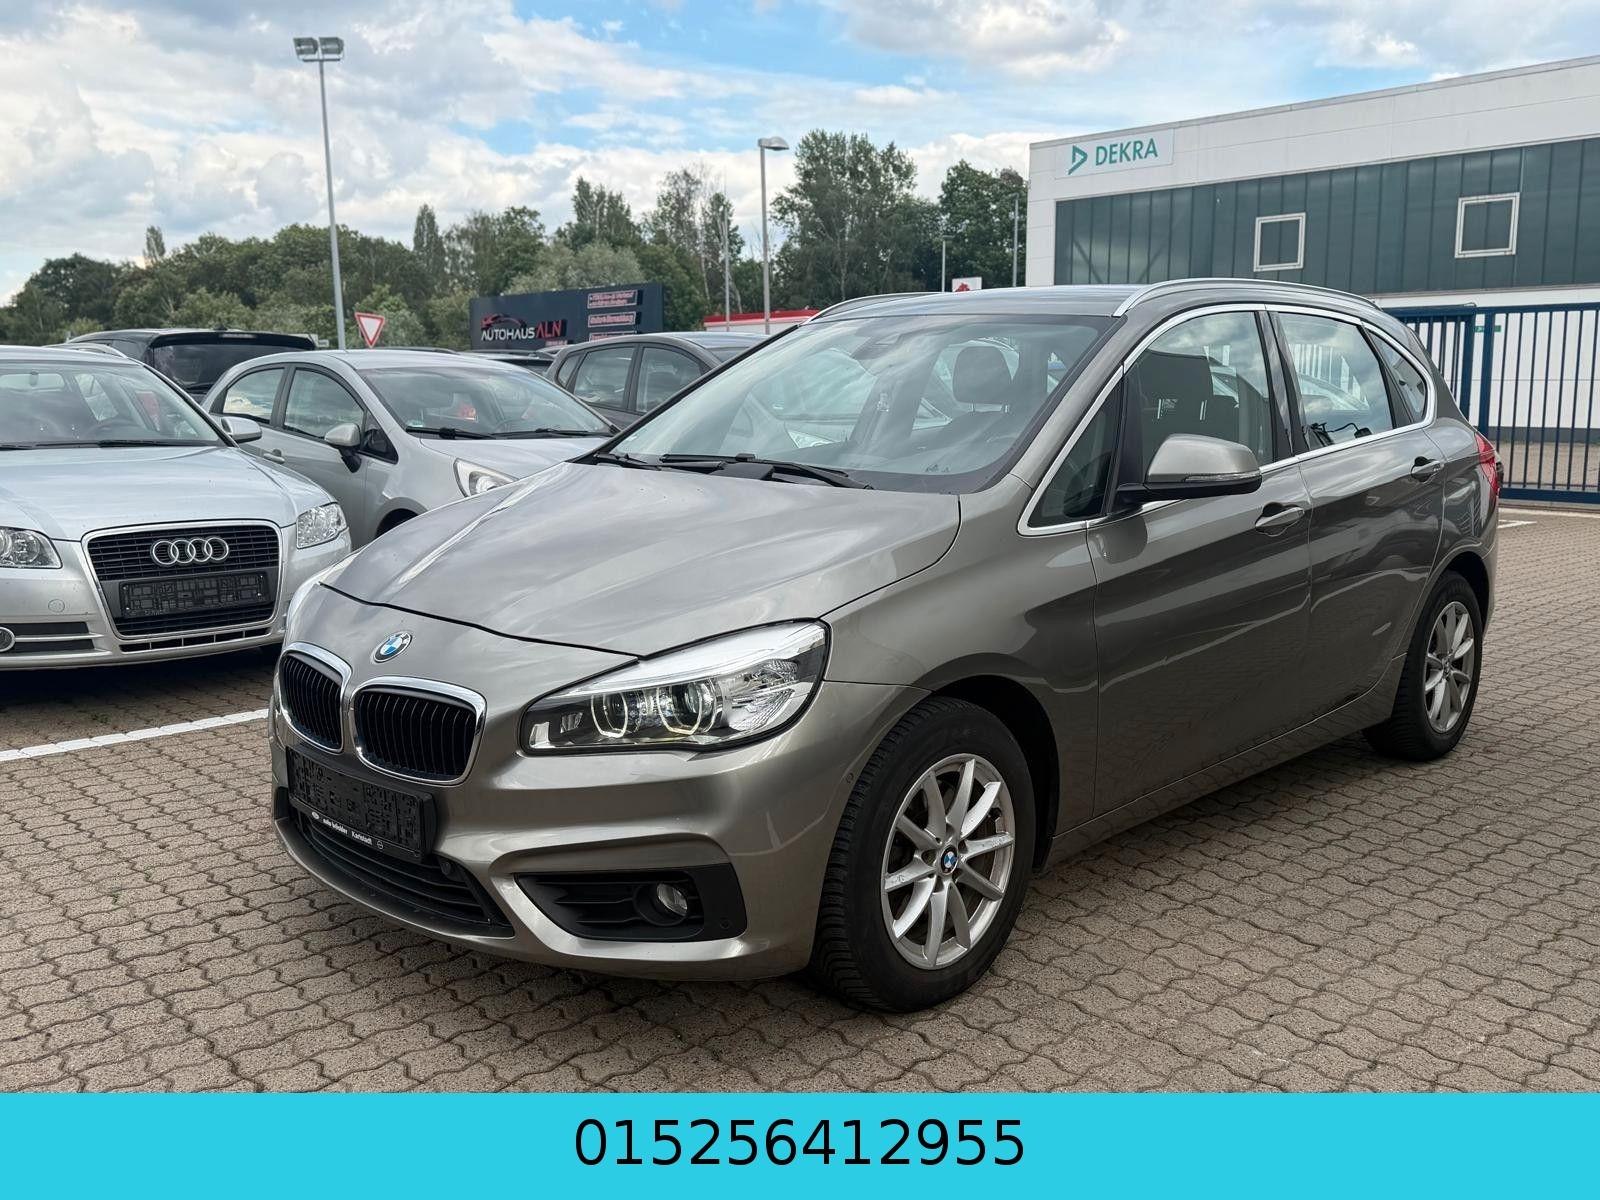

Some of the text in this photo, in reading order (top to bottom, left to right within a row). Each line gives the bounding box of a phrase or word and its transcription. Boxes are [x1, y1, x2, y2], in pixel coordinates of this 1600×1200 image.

[1096, 138, 1158, 166] DEKRA
[481, 320, 562, 341] AUTOHAUS ALN
